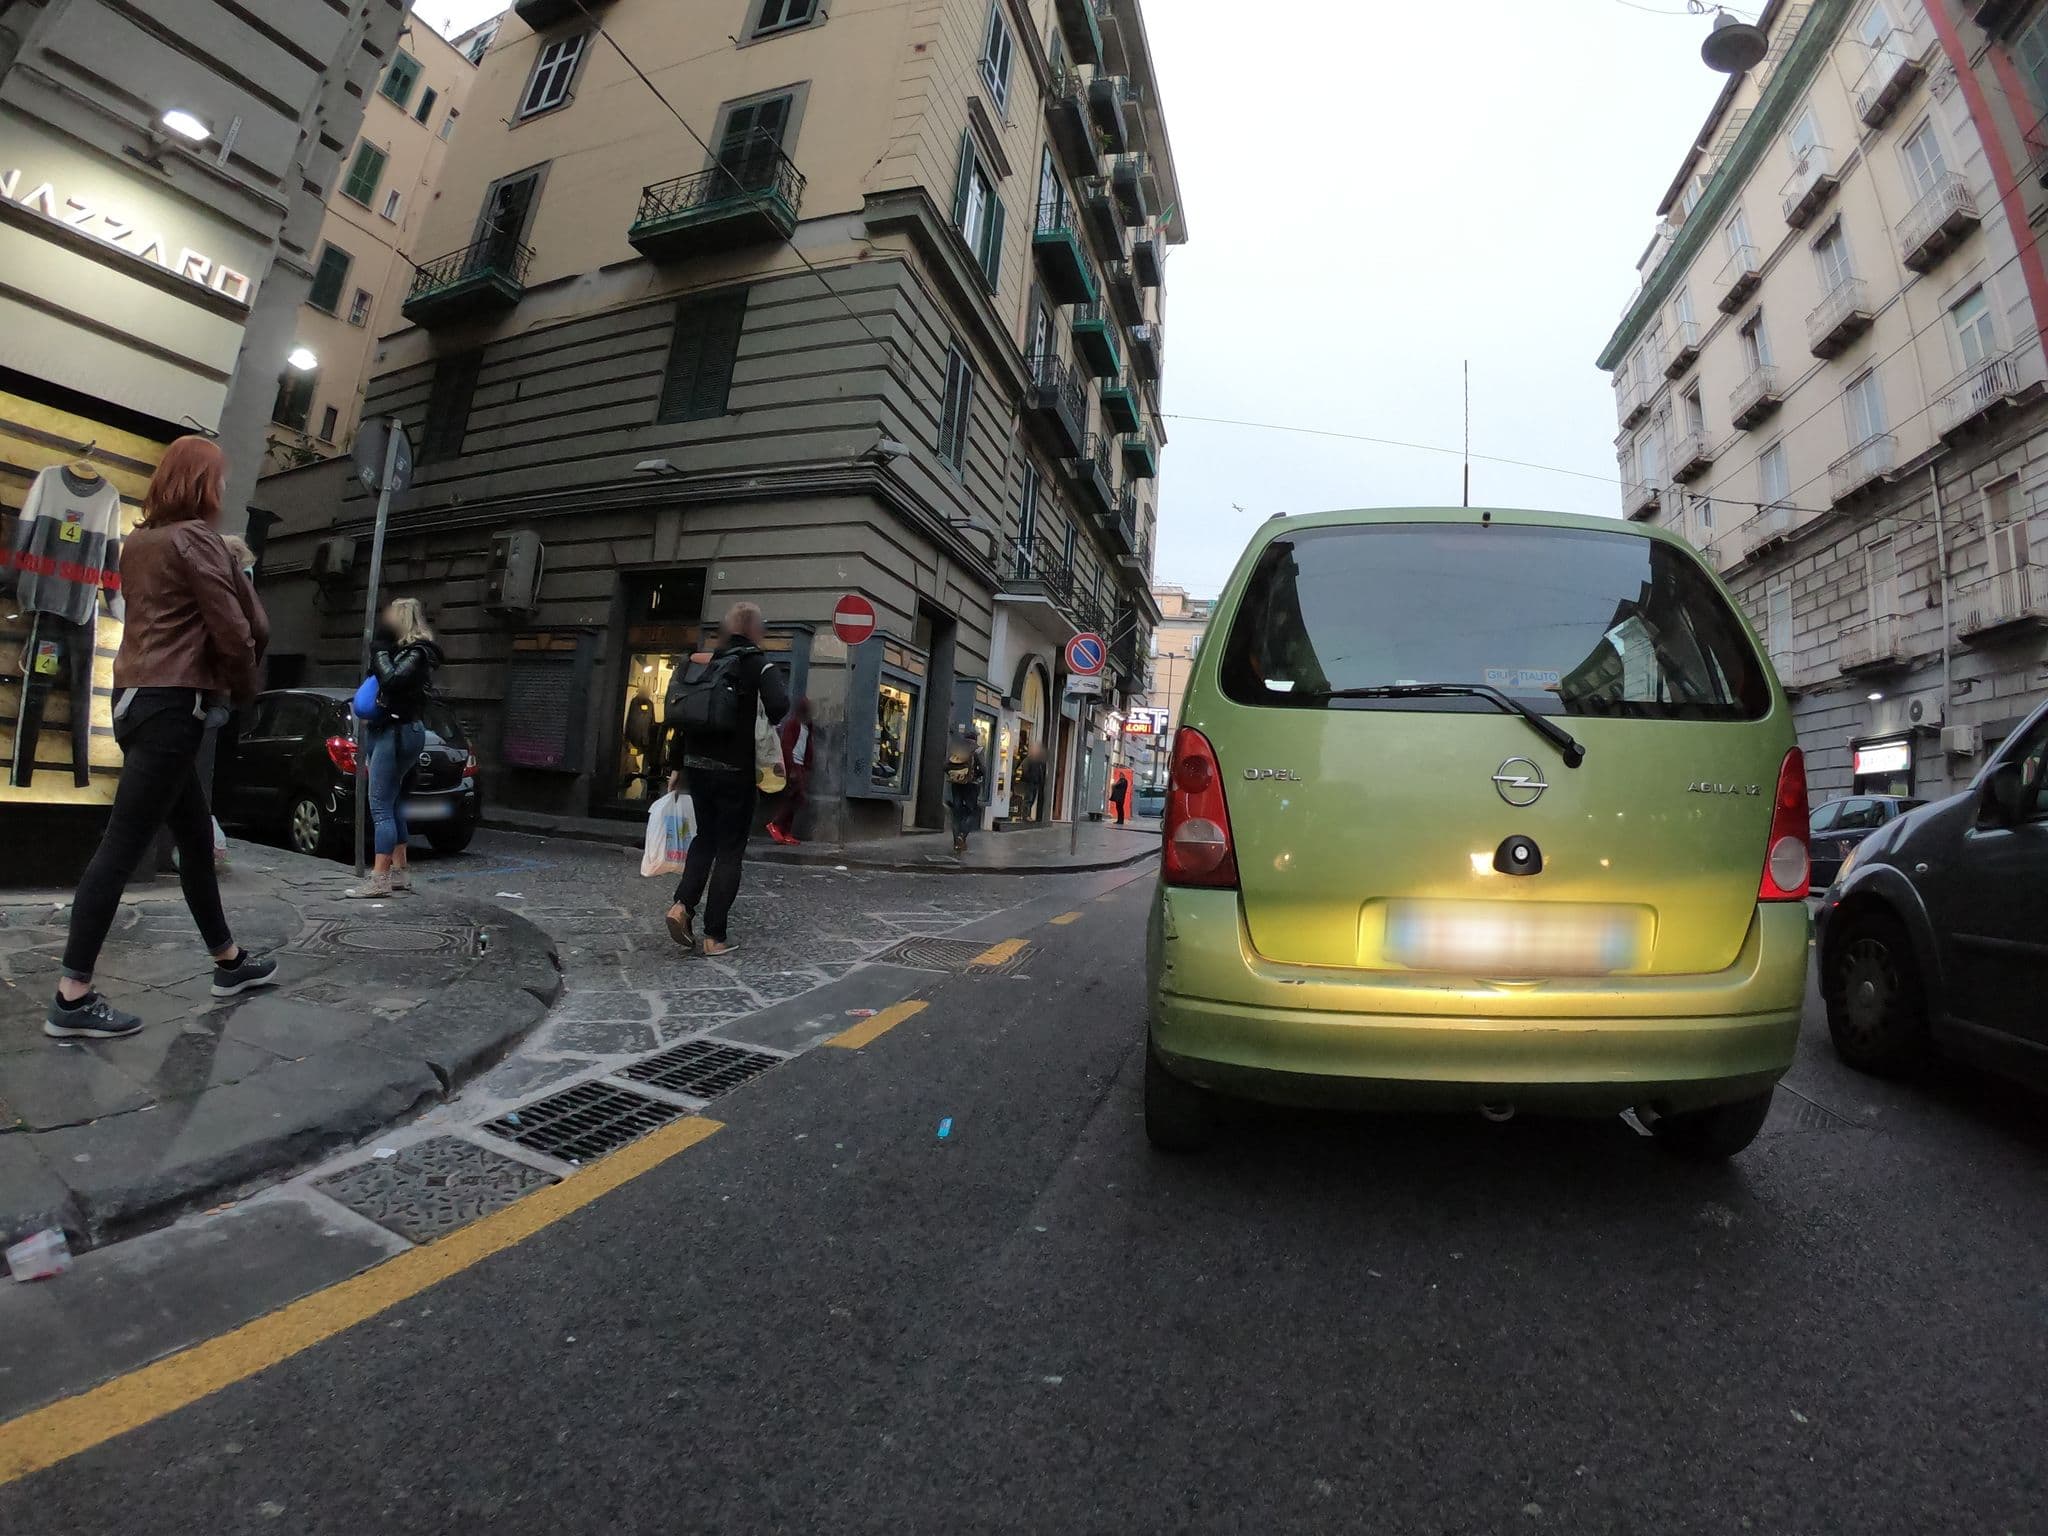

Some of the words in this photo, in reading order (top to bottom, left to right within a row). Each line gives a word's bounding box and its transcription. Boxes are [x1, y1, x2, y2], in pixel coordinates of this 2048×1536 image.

[66, 526, 75, 540] 4
[1243, 768, 1302, 781] OPEL
[1687, 781, 1739, 795] AGILA
